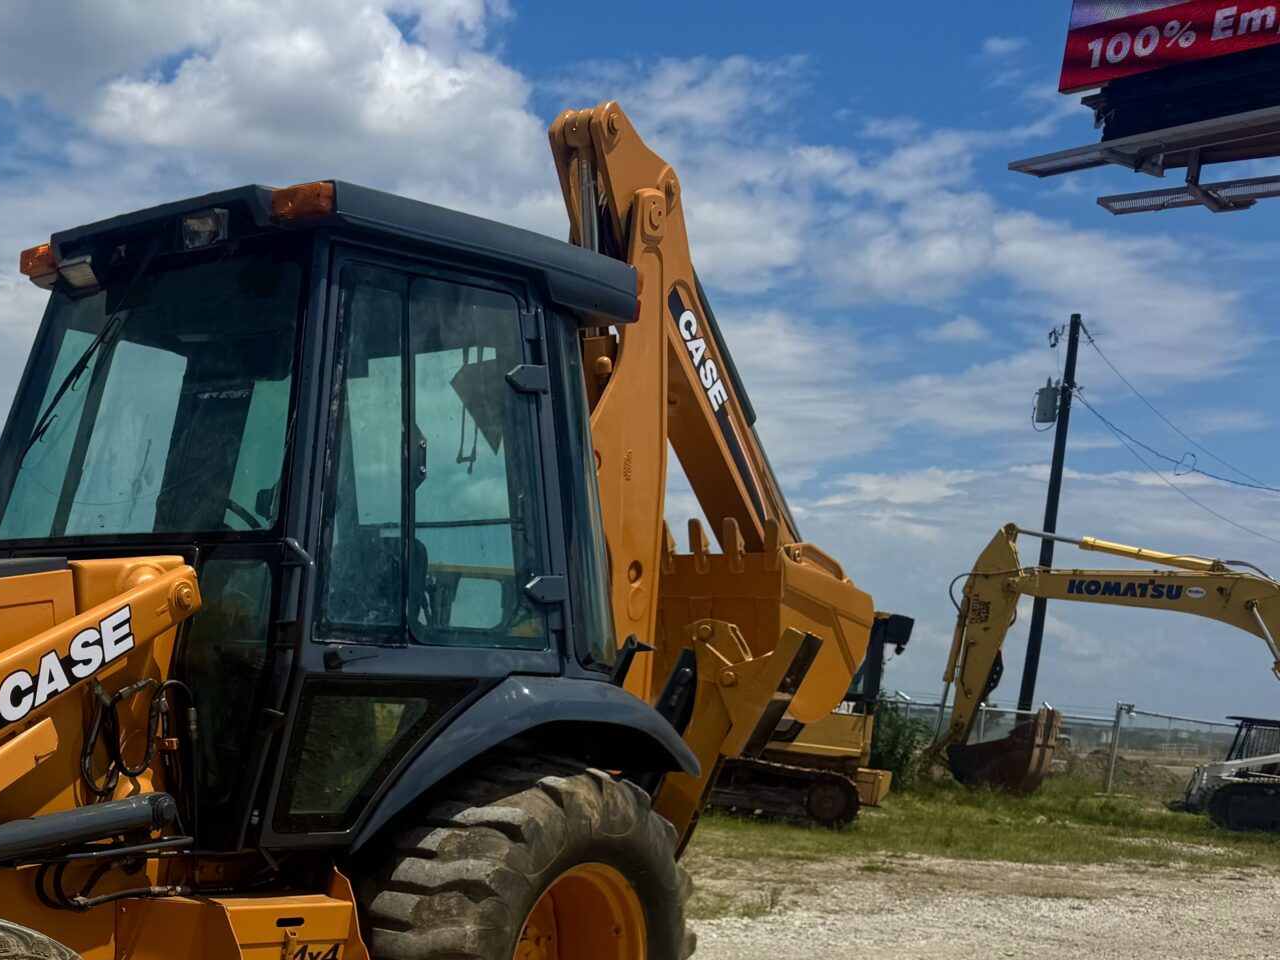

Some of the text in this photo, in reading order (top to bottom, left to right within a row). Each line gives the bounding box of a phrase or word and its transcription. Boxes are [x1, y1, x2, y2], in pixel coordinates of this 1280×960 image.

[1088, 5, 1280, 69] 100% Em
[678, 309, 729, 413] CASE
[1067, 578, 1184, 601] KOMATSU
